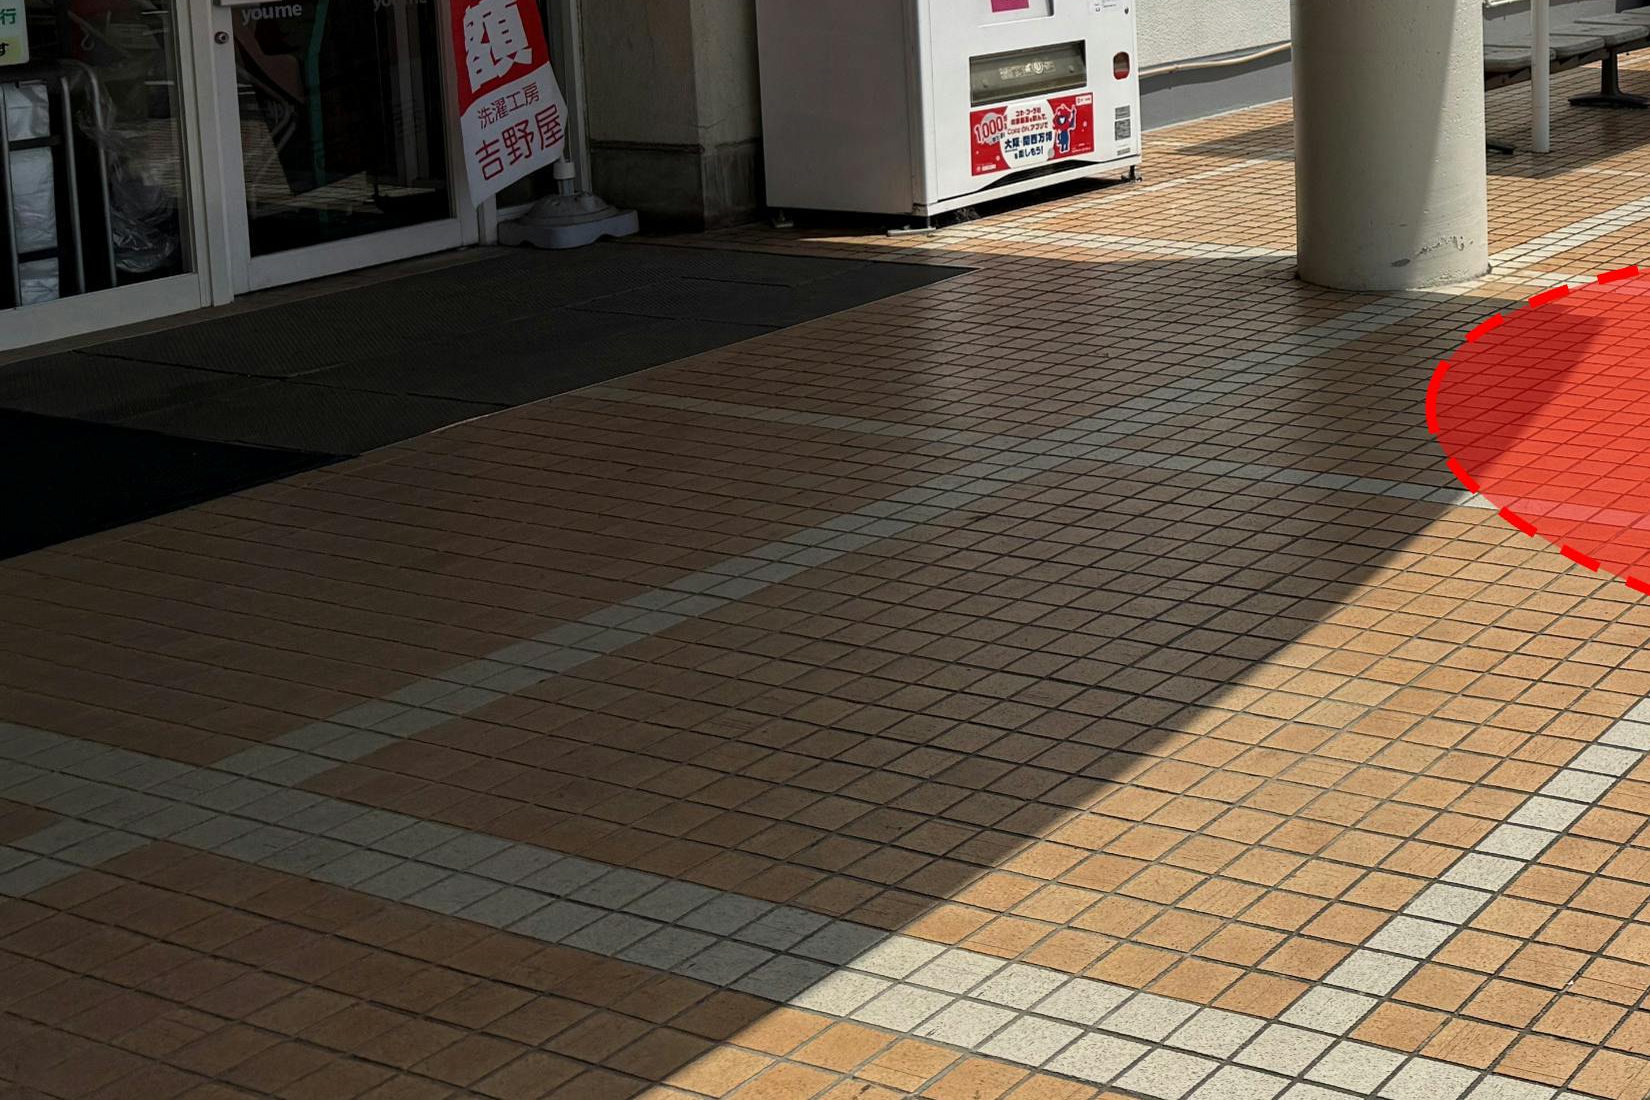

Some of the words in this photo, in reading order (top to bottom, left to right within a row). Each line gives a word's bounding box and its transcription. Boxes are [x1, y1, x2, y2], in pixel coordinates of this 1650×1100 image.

[241, 2, 303, 26] youme
[477, 82, 541, 129] 洗濯工房
[475, 104, 565, 181] 吉野屋
